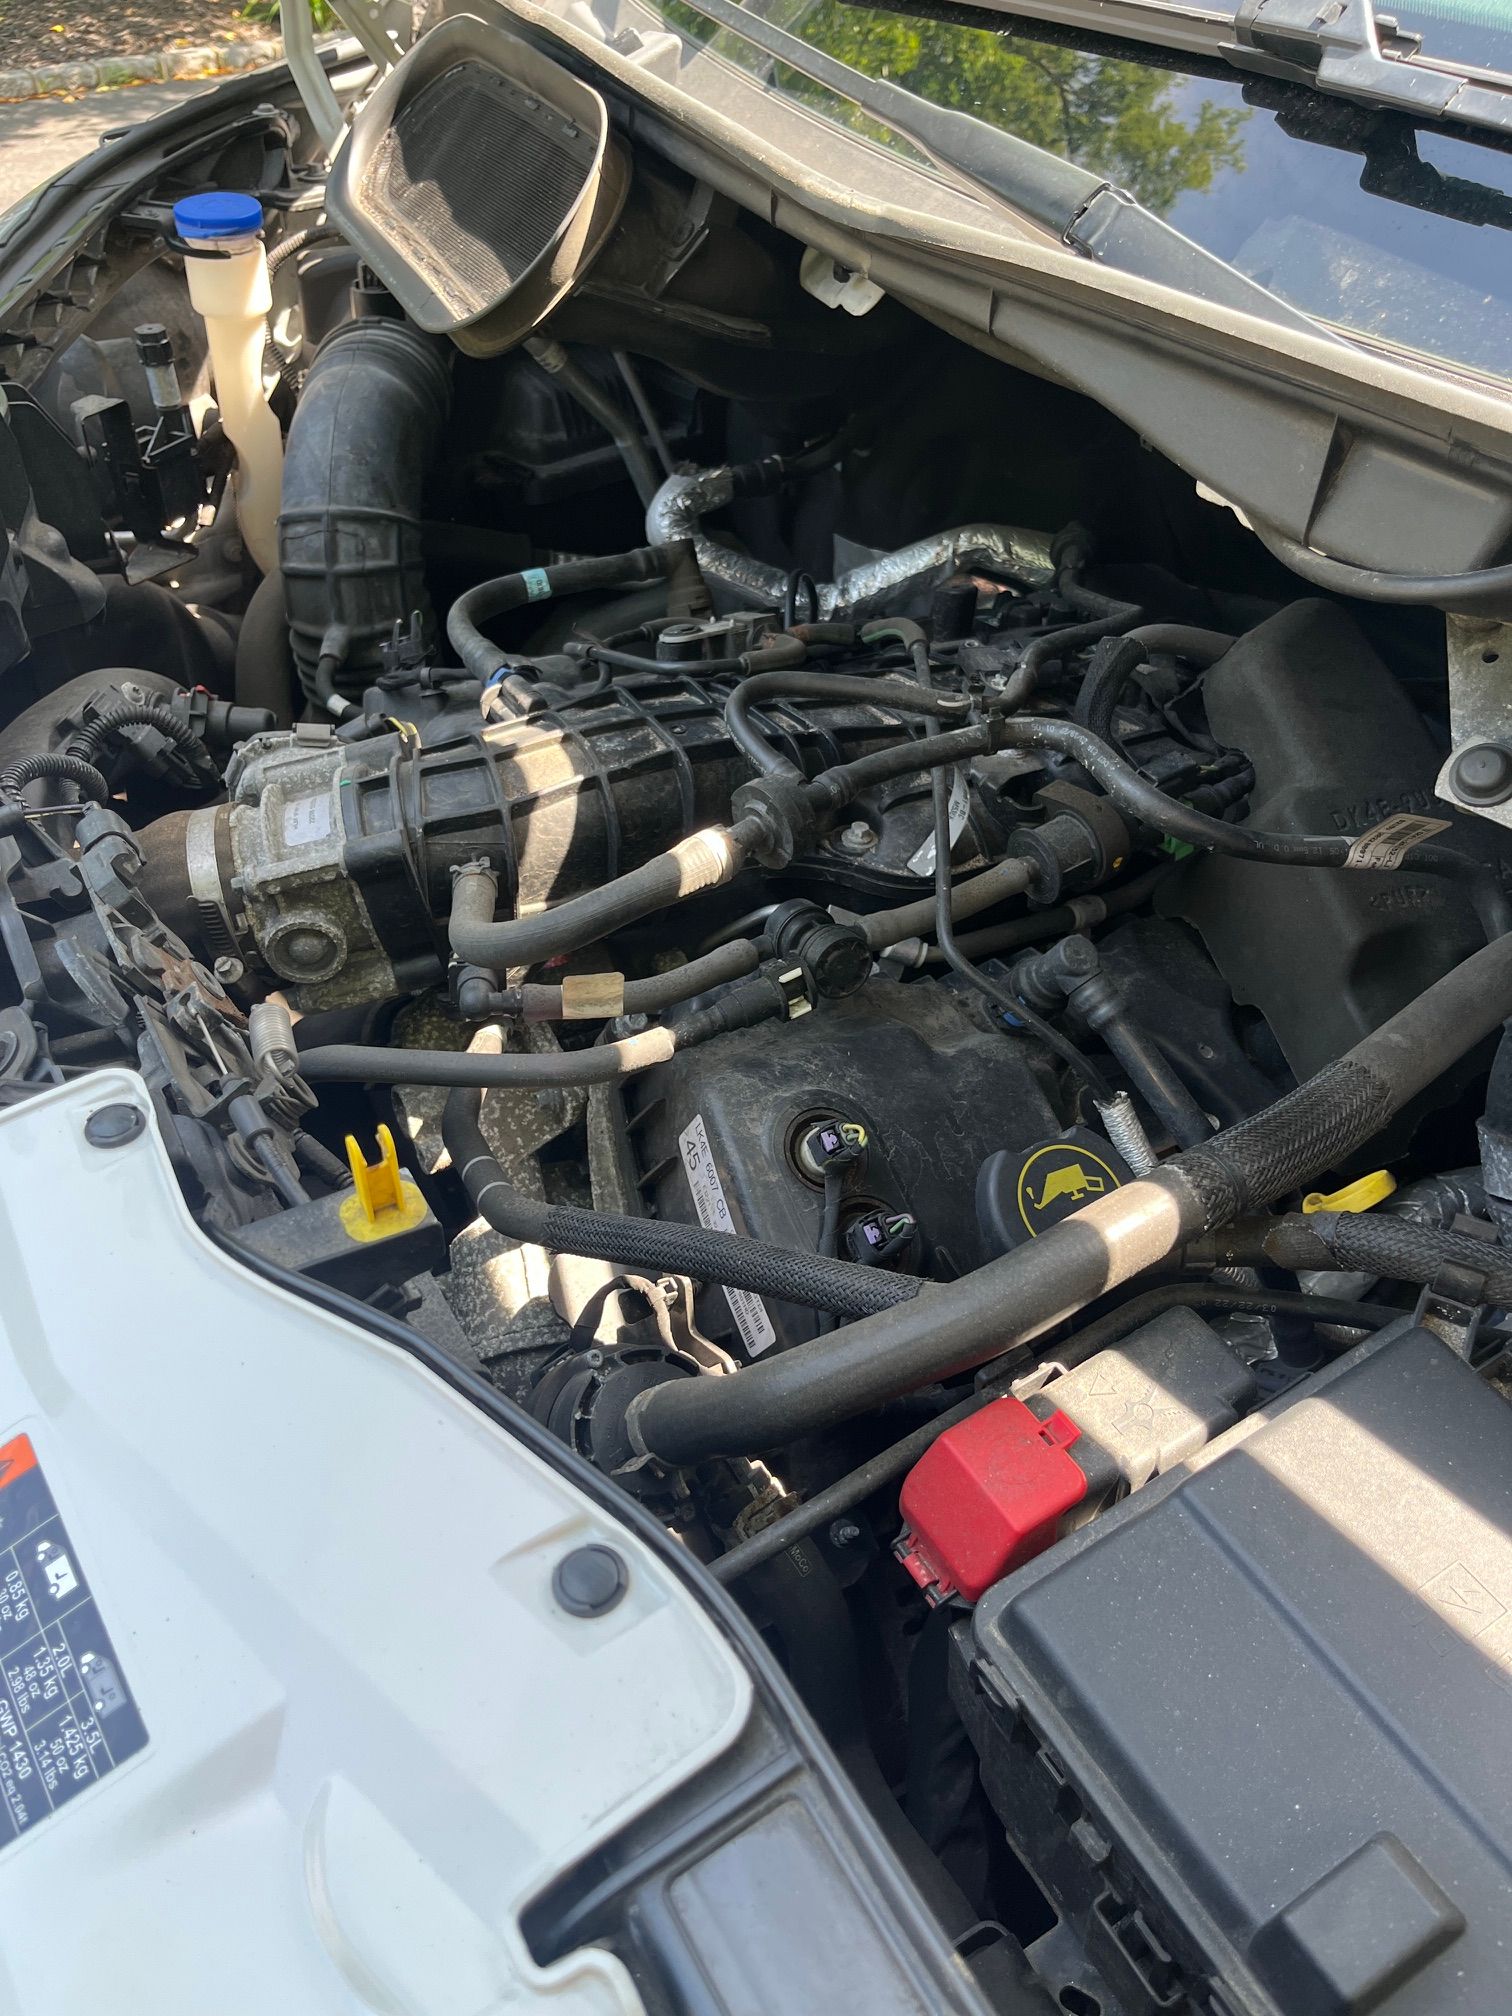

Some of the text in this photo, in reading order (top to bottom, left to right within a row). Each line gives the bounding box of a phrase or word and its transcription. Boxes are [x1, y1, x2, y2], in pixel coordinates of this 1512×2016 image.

[685, 1140, 701, 1172] 45
[704, 1163, 720, 1192] 6007
[715, 1198, 728, 1220] CB
[5, 1570, 30, 1622] 0.85 kg
[23, 1665, 41, 1698] 48 oz
[33, 1646, 59, 1700] 1.35 kg
[52, 1643, 71, 1679] 2.0L
[8, 1667, 30, 1715] 2.98 lbs
[50, 1738, 70, 1775] 50 oz
[58, 1715, 90, 1780] 1.425 kg
[80, 1717, 103, 1756] 3.5L
[9, 1741, 33, 1780] 1430
[34, 1739, 59, 1791] 3.14 lbs
